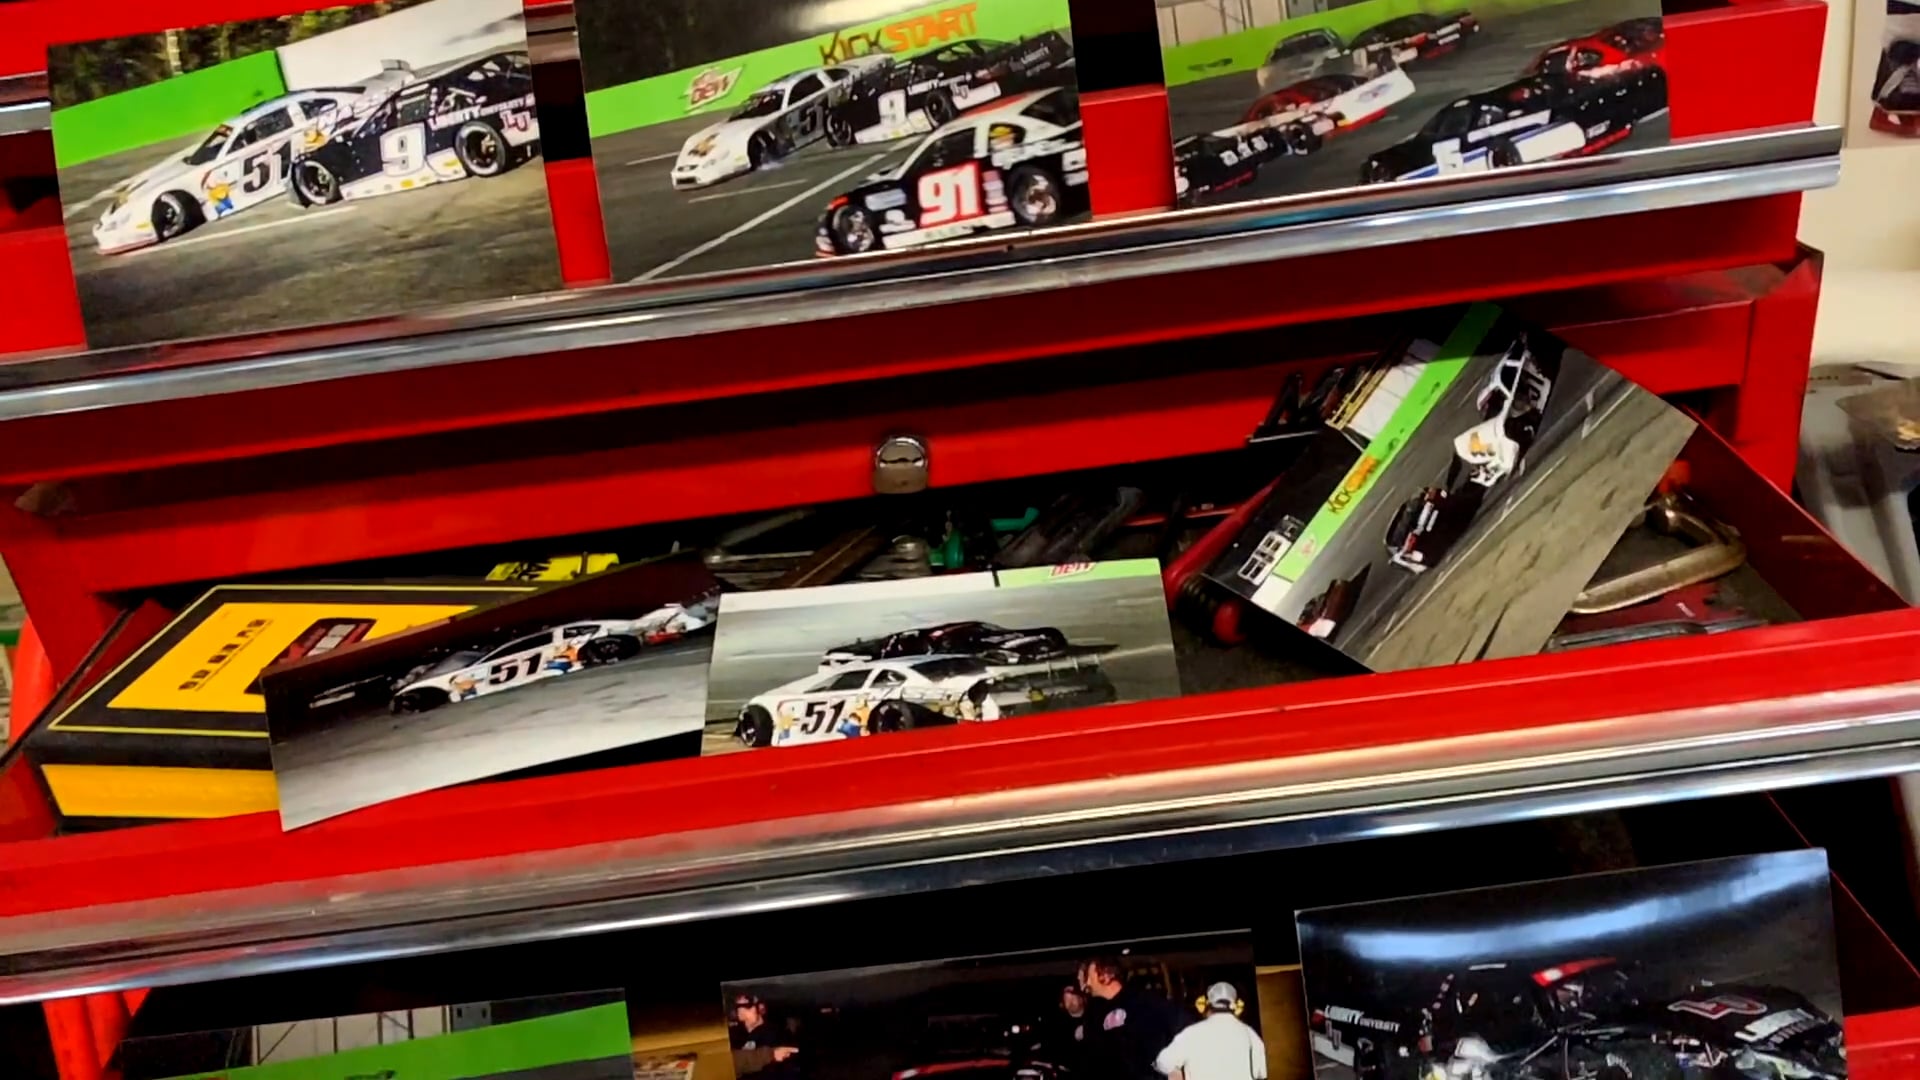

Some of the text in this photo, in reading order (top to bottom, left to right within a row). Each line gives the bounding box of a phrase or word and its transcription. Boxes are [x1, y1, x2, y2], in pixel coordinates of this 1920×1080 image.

[877, 89, 906, 124] 9
[242, 141, 293, 194] 51
[380, 122, 427, 177] 9
[918, 162, 980, 228] 91
[489, 652, 542, 685] 51
[800, 699, 846, 735] 51
